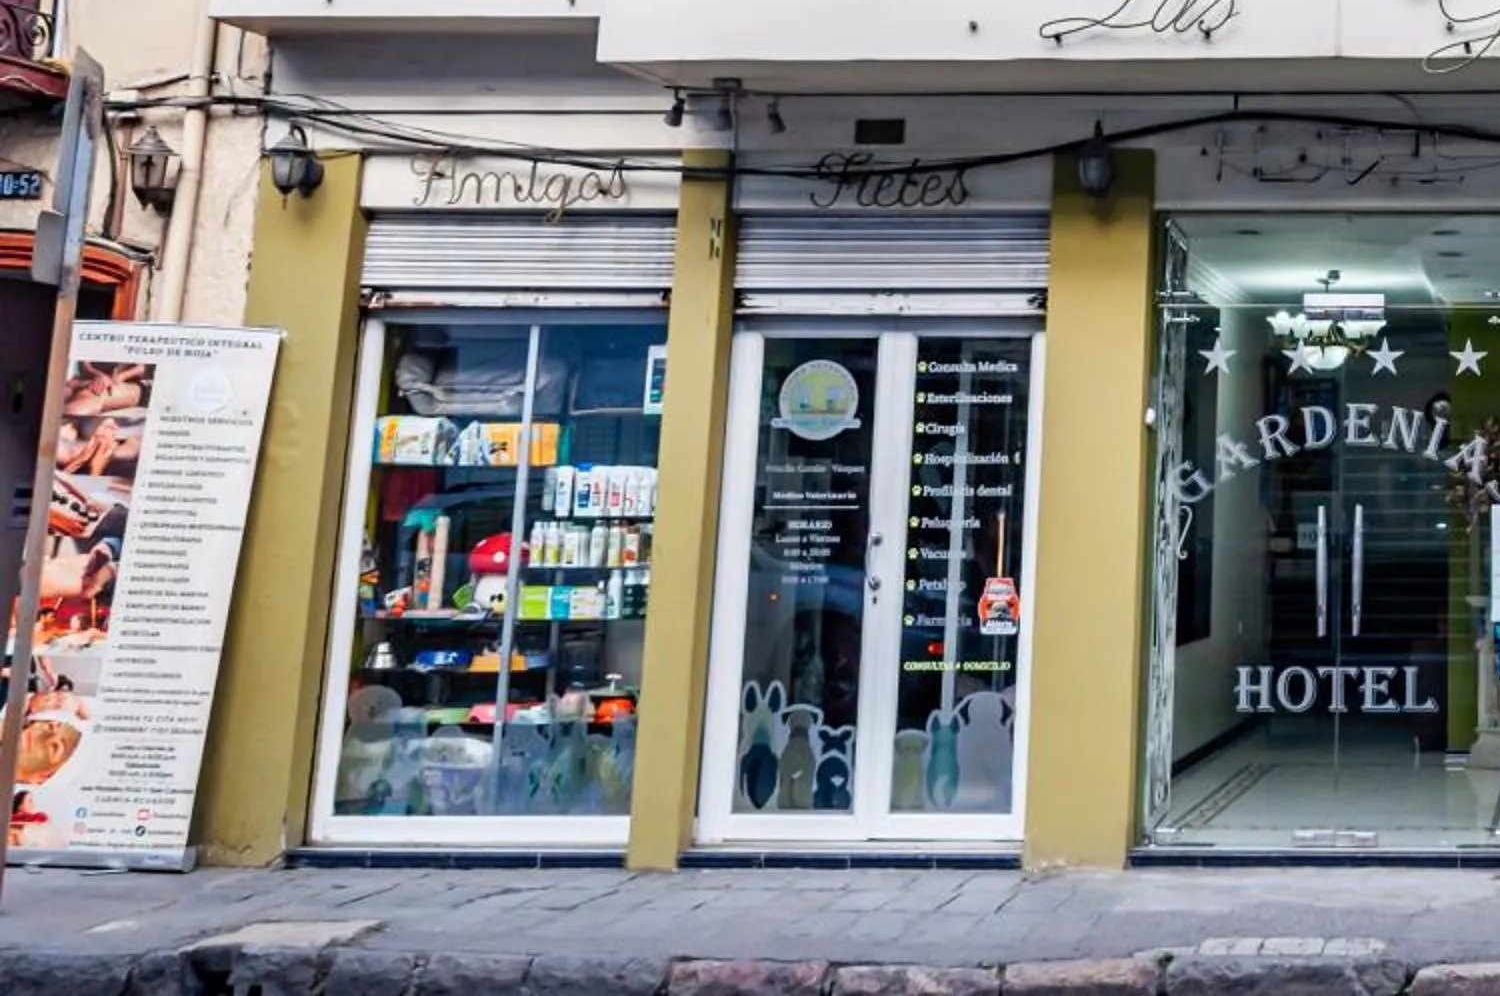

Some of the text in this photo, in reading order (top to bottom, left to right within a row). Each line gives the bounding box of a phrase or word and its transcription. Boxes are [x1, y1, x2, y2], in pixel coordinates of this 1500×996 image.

[410, 152, 628, 223] Amigos
[976, 484, 1013, 497] dental
[921, 516, 981, 530] Peluqría
[917, 613, 973, 627] Farmcia
[1234, 665, 1439, 713] HOTEL
